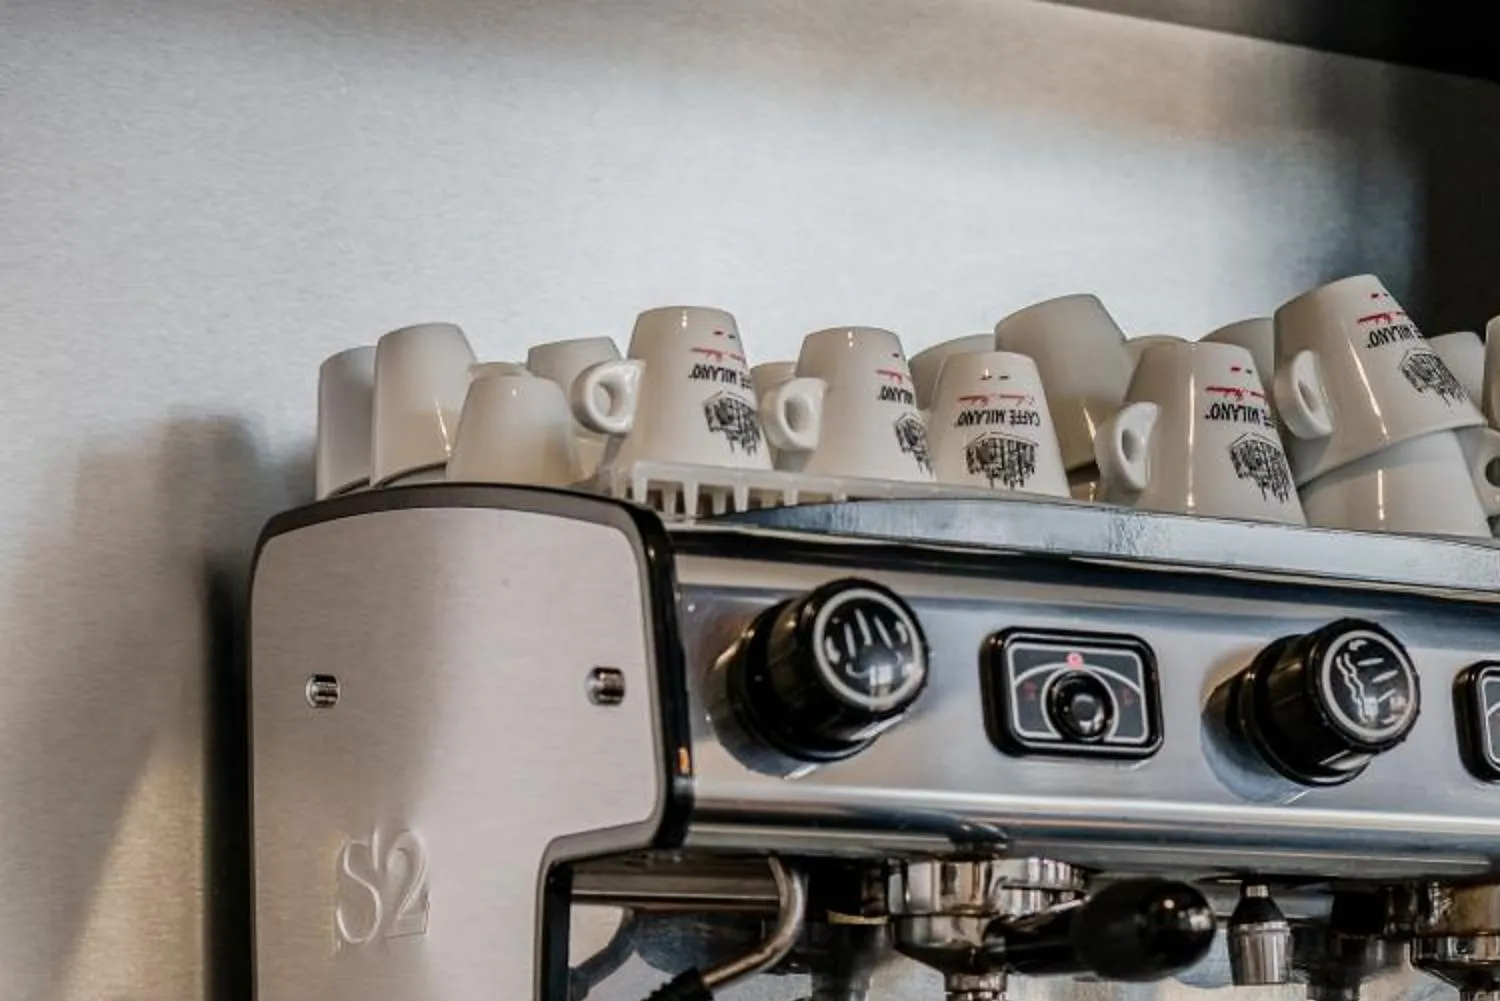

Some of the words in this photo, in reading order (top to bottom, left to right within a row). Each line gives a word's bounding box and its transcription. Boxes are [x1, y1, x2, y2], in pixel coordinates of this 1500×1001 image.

[688, 364, 737, 384] MILANO
[956, 408, 1006, 427] MILANO
[1205, 401, 1260, 424] MILANO
[334, 827, 431, 954] S2
